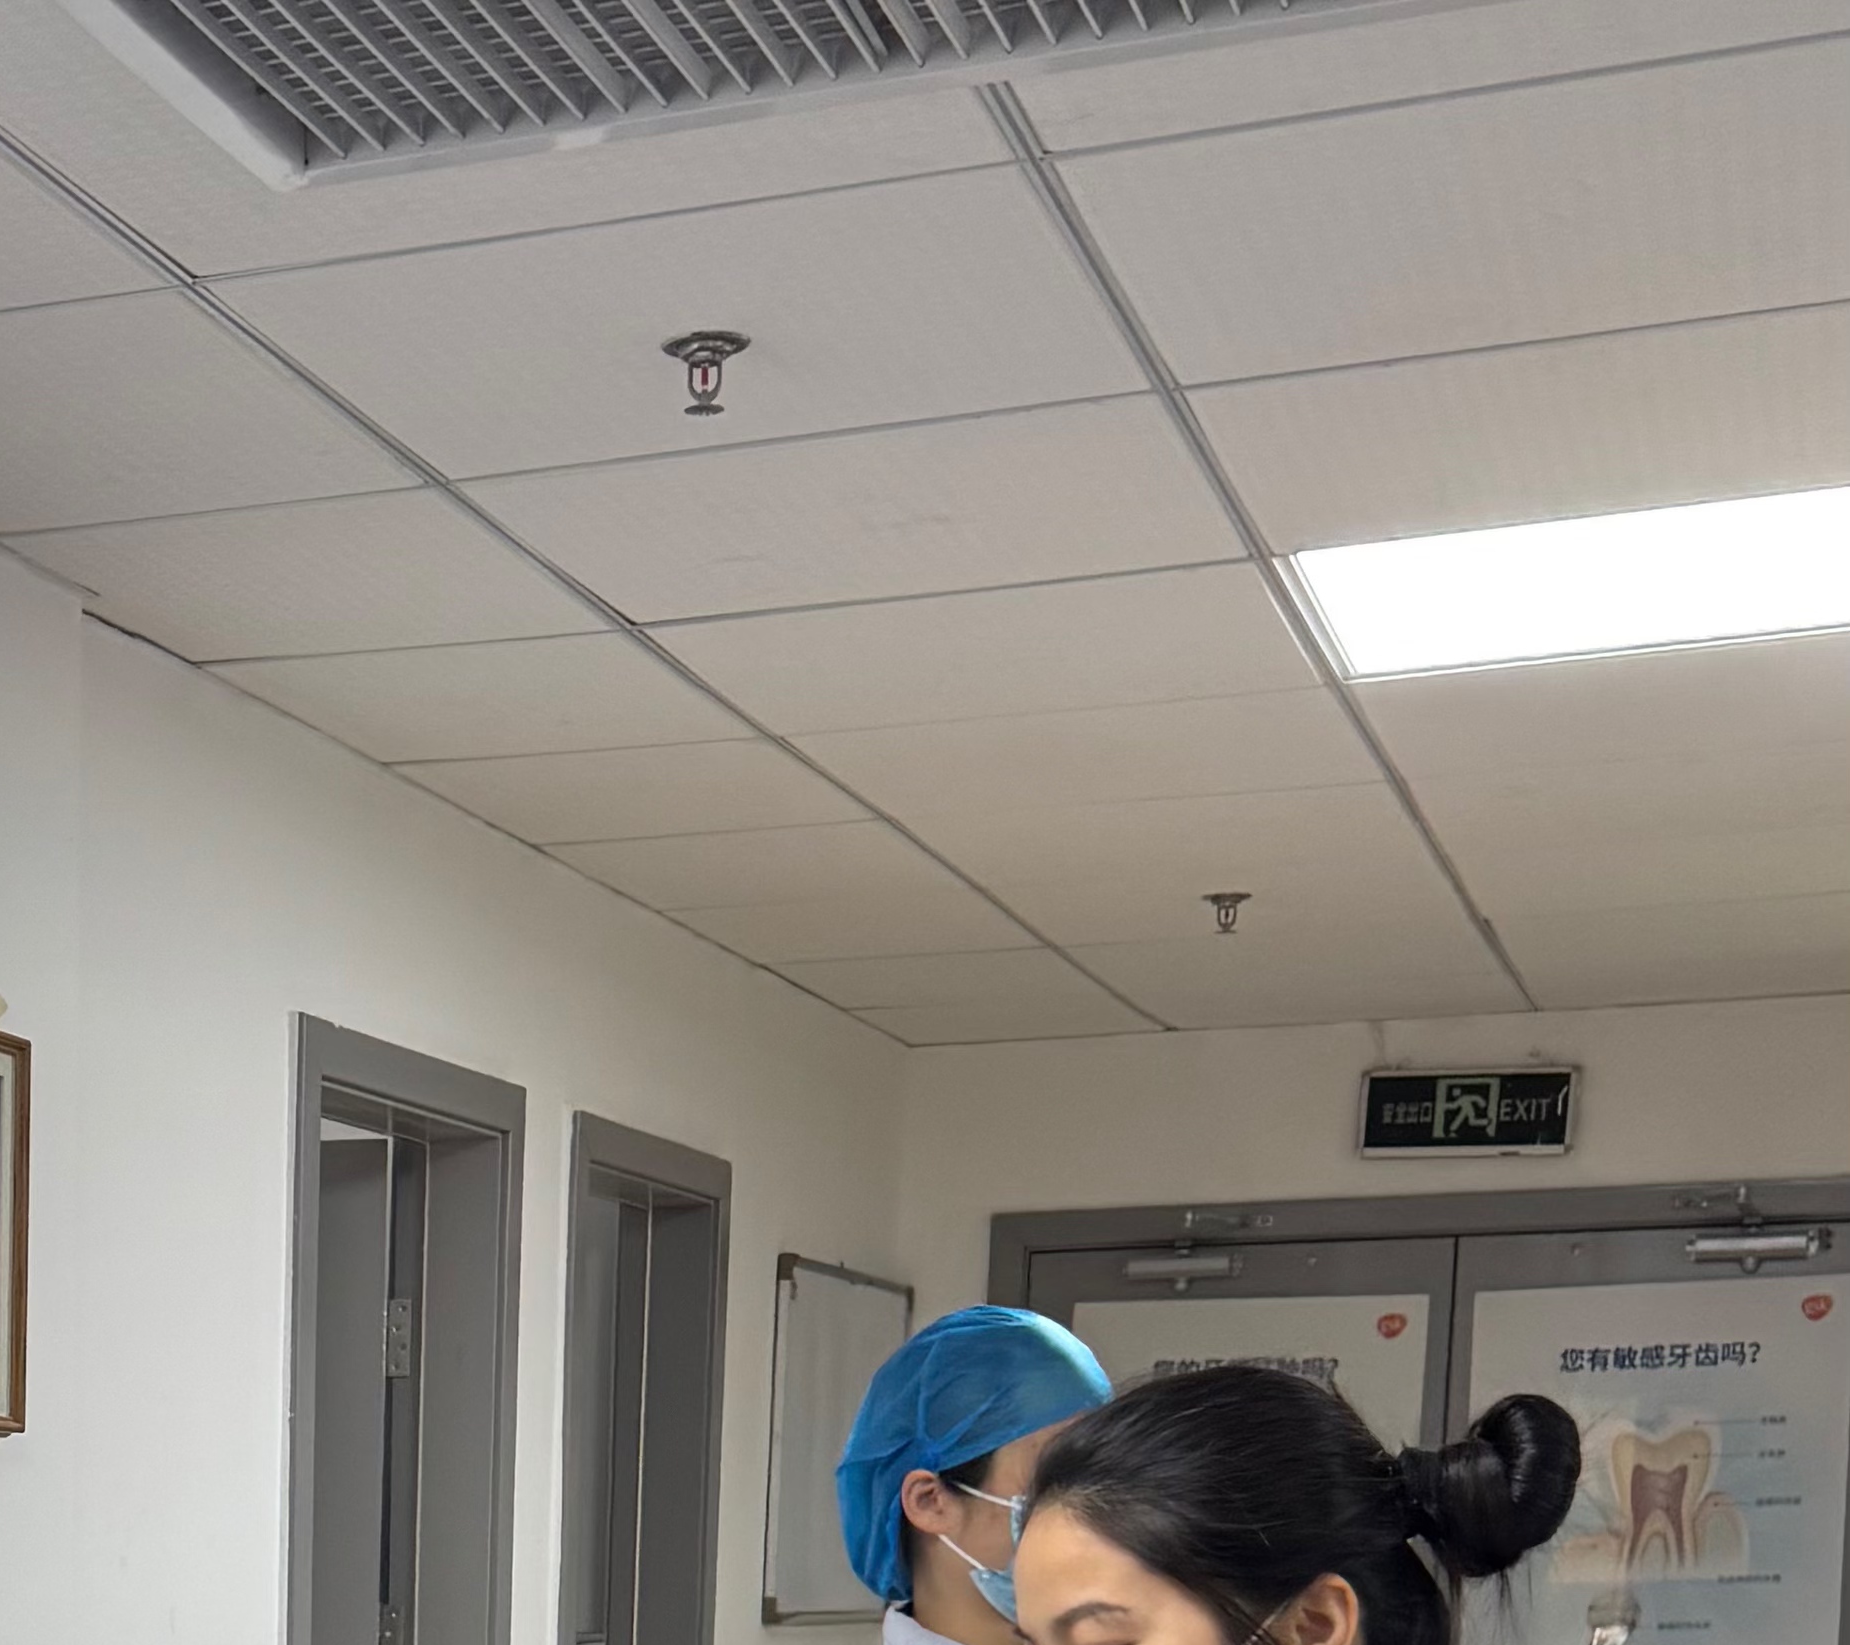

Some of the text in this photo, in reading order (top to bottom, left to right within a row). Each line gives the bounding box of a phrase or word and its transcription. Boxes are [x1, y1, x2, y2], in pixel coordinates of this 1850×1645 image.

[1500, 1098, 1550, 1121] EXIT
[1560, 1342, 1761, 1373] 您有敏感牙齿吗?
